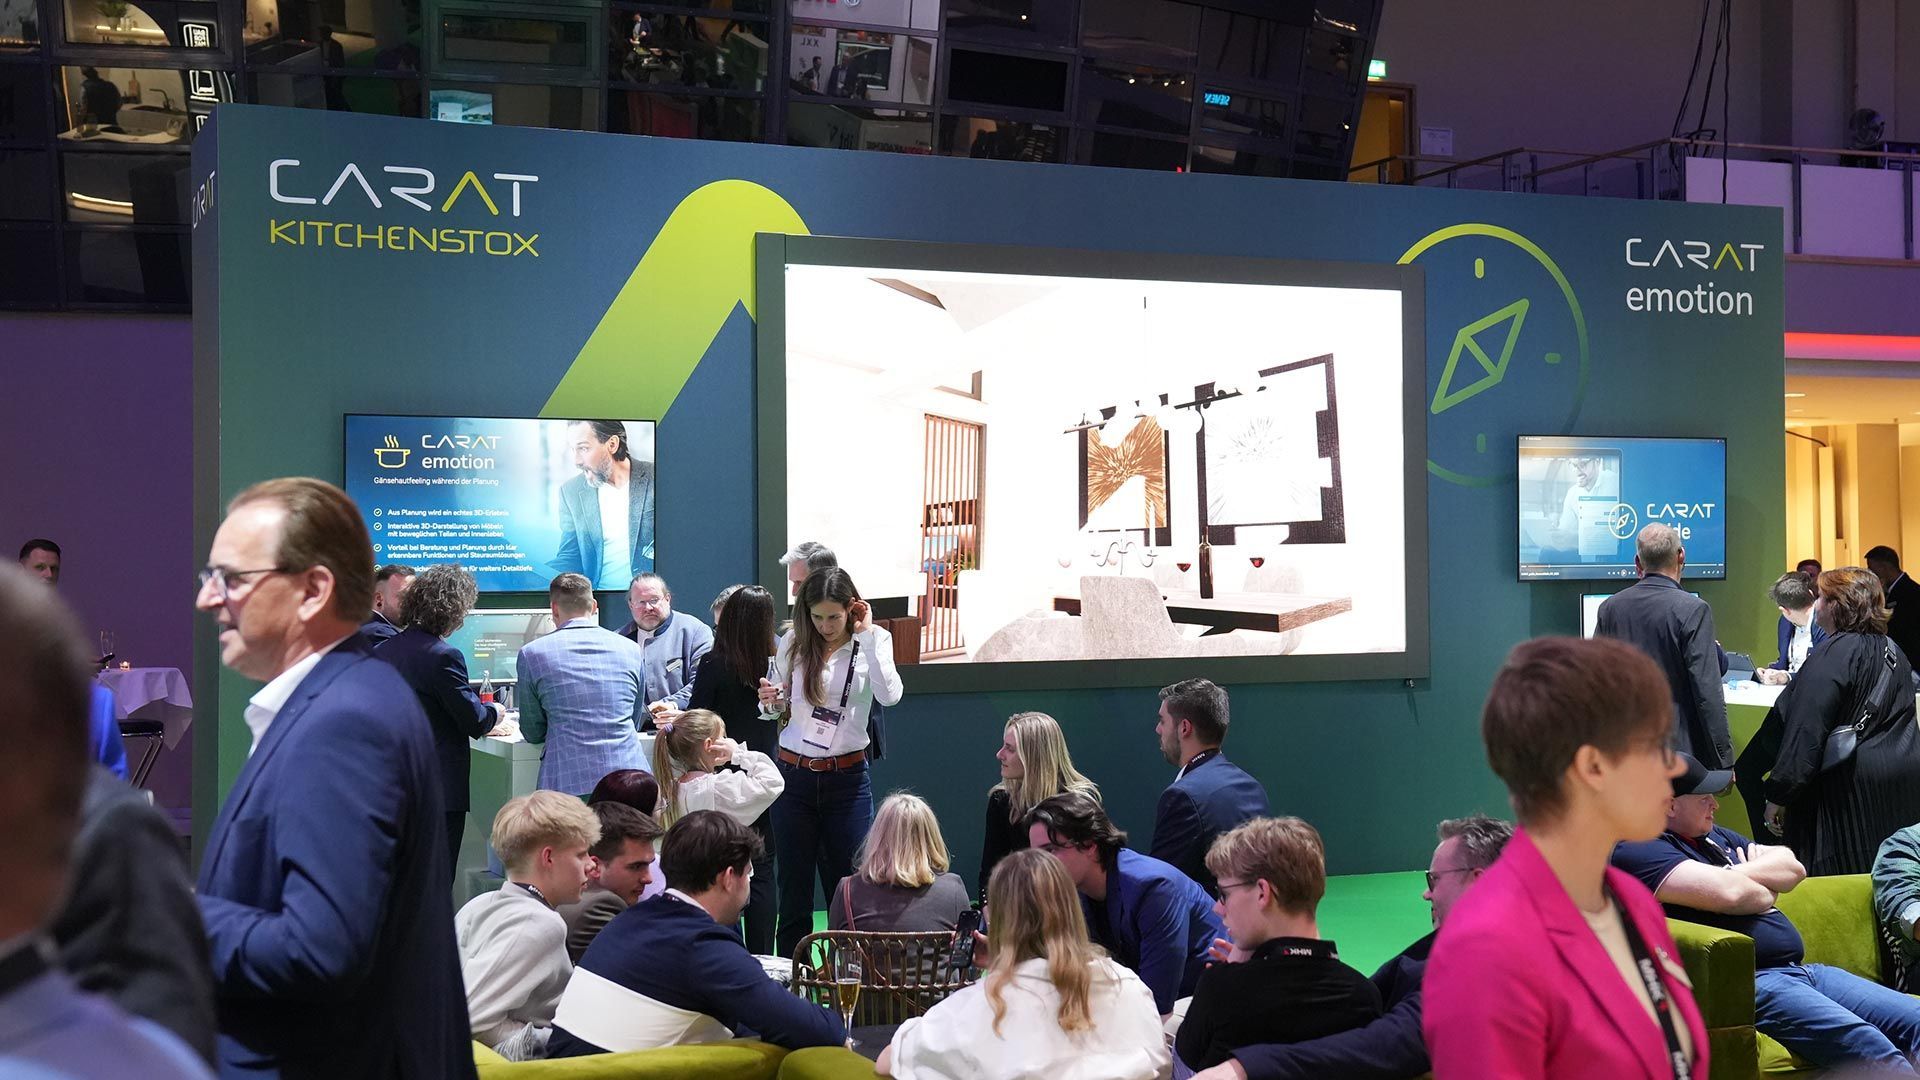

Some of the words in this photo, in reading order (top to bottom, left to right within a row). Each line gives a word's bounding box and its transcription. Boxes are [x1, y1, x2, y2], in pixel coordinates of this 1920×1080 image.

[269, 158, 539, 217] CARAT
[193, 170, 216, 230] CARAT
[270, 218, 539, 257] KITCHENSTOX
[1625, 237, 1764, 272] CARAT
[1626, 282, 1753, 316] emotion
[422, 434, 502, 450] CARAT
[422, 454, 495, 470] emotion
[374, 477, 430, 486] Gänsehautfeeling
[431, 477, 460, 485] während
[473, 478, 499, 486] Planung
[401, 509, 427, 517] Planung
[1646, 503, 1715, 518] CARAT
[399, 530, 437, 538] beweglichen
[421, 523, 468, 531] 3D-Darstellung
[420, 544, 448, 552] Beratung
[462, 544, 487, 552] Planung
[469, 552, 526, 560] Stauraumlösungen
